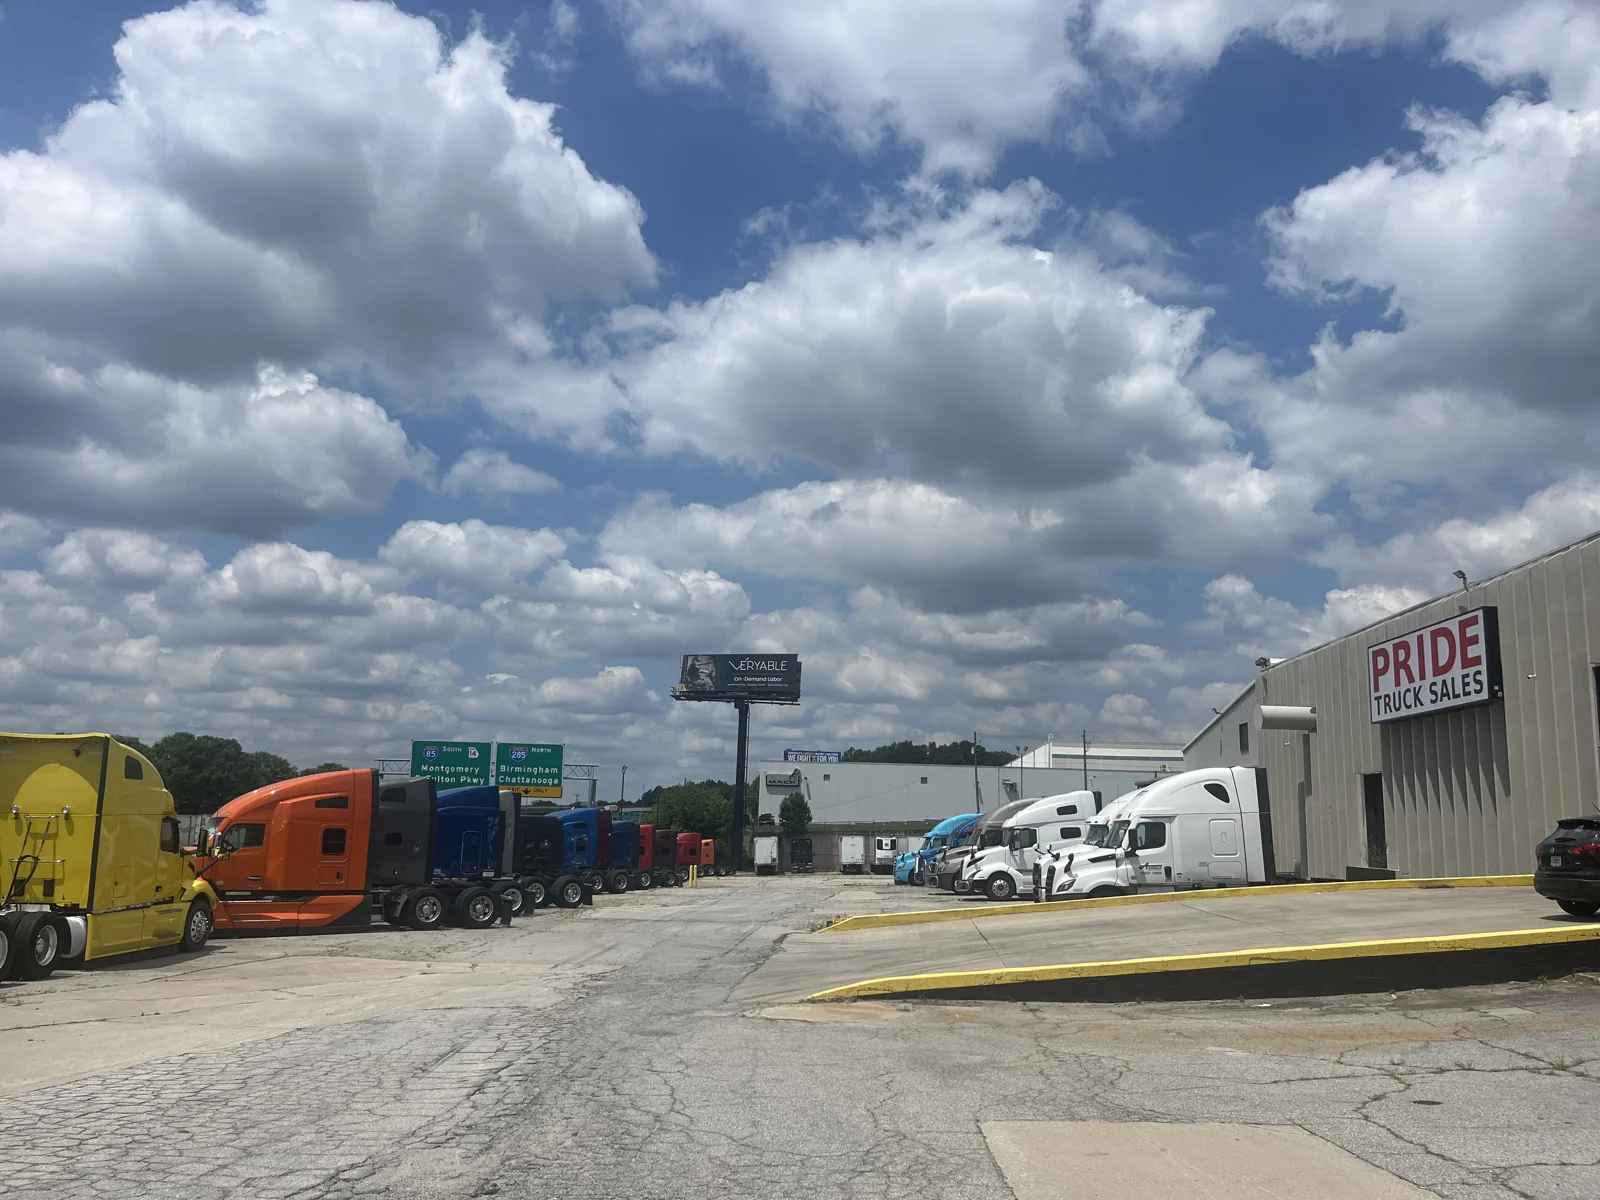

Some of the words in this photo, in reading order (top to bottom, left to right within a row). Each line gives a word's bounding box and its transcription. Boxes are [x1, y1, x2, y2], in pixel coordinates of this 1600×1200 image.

[1371, 614, 1482, 693] PRIDE
[728, 657, 788, 671] VERYABLE
[1374, 685, 1424, 716] TRUCK
[1429, 670, 1484, 704] SALES
[425, 750, 436, 758] 85
[421, 764, 480, 775] Montgomery
[500, 764, 559, 775] Birmingham
[460, 776, 485, 786] Pkwy
[499, 775, 559, 786] Chattanooga
